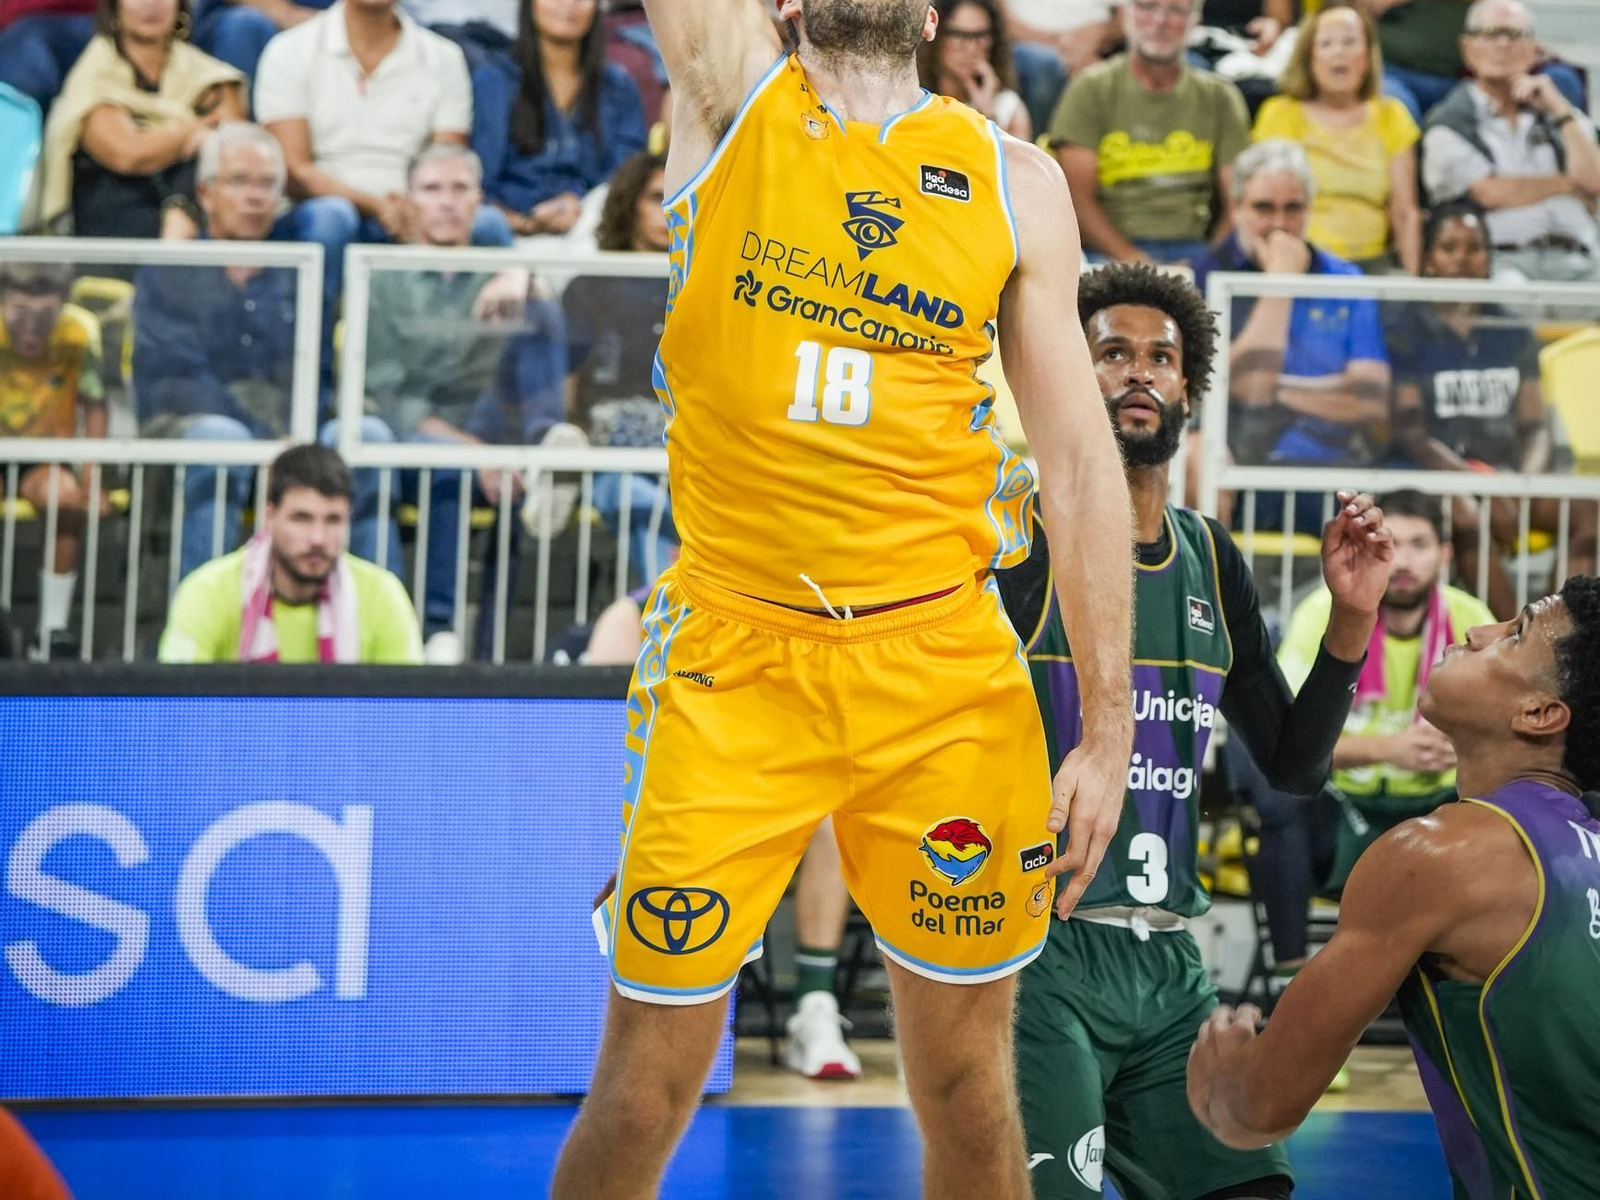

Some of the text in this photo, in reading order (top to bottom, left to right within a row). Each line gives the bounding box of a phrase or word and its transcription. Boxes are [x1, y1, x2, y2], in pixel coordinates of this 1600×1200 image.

[925, 171, 945, 184] liga
[925, 181, 967, 198] endesa
[741, 231, 964, 329] DREAMLAND
[787, 340, 873, 426] 18
[1127, 752, 1197, 799] álag
[1024, 854, 1048, 871] acb
[1126, 832, 1168, 904] 3
[910, 879, 1005, 912] Poema
[911, 908, 1005, 937] del Mar
